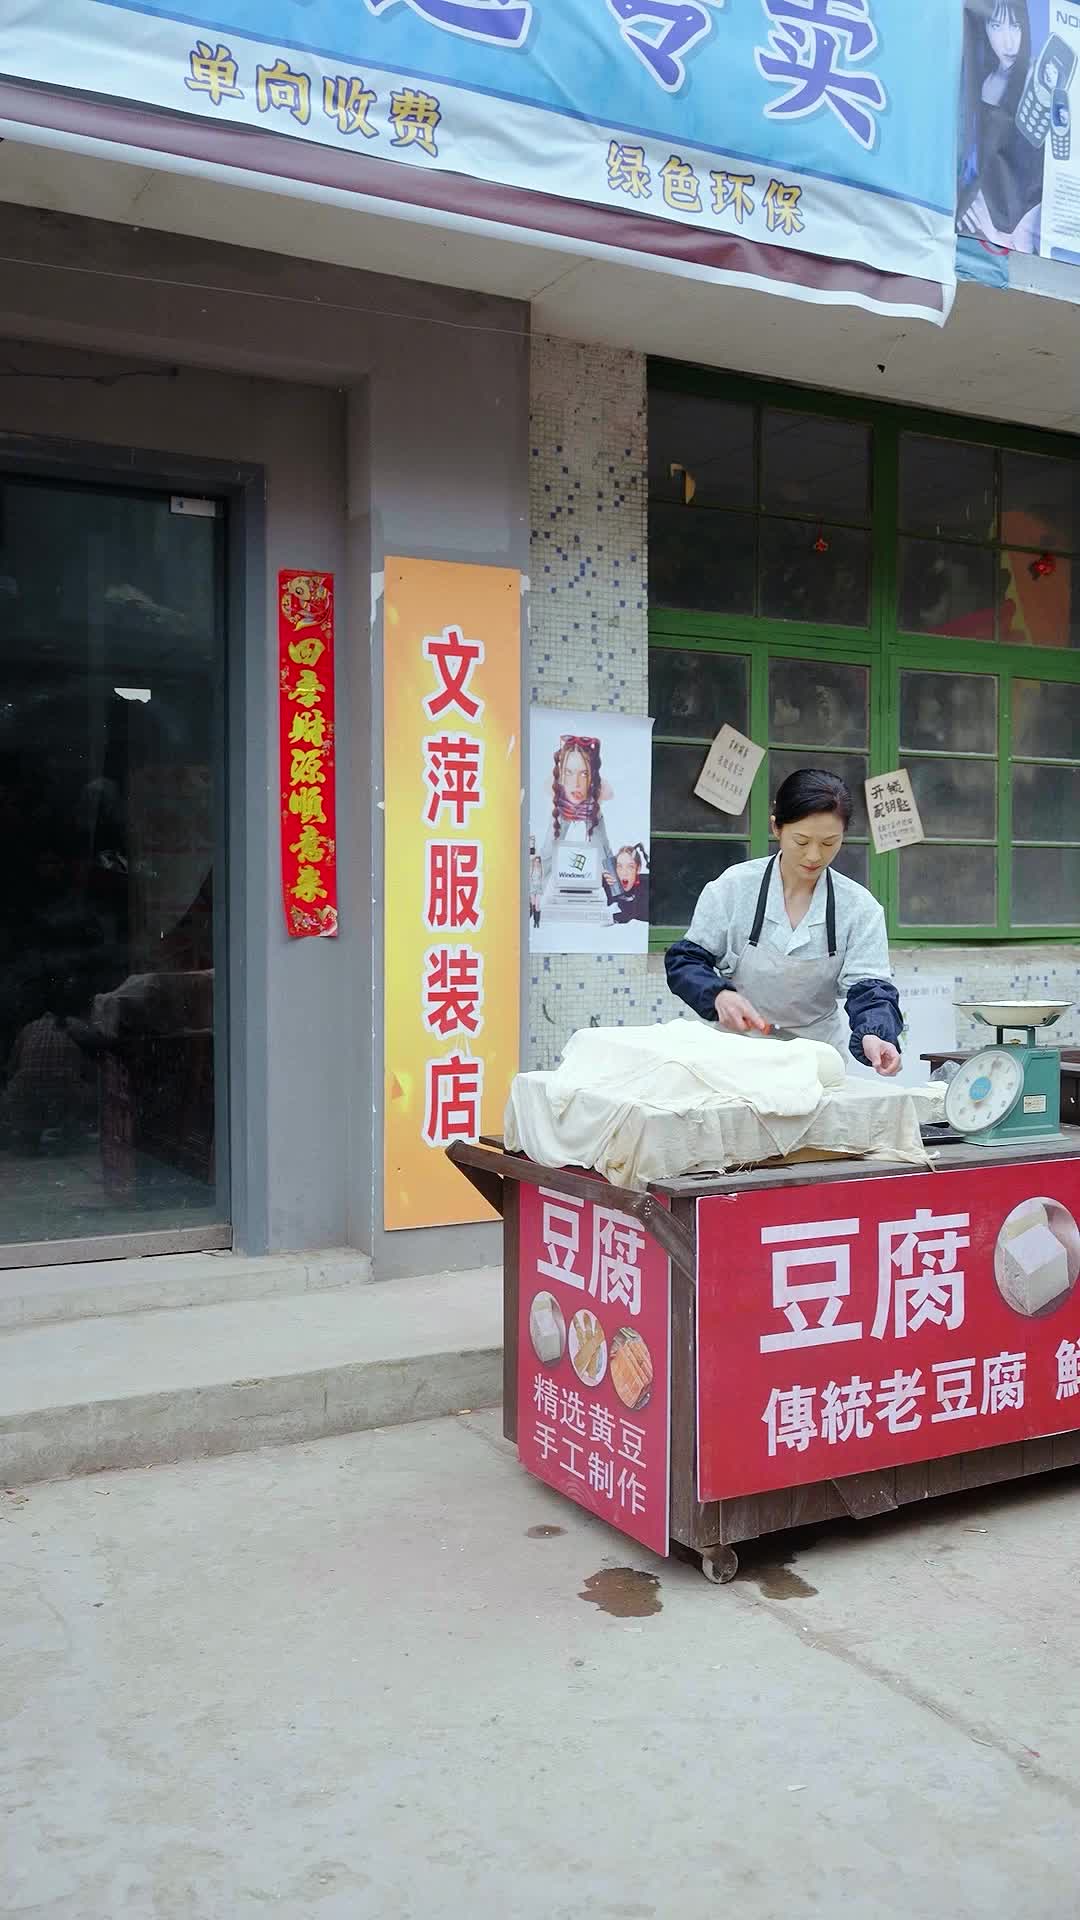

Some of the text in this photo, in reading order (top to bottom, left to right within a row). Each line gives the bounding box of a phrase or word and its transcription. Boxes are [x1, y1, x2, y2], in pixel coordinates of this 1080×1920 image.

[1056, 10, 1080, 28] NO
[184, 40, 443, 158] 单向收费
[606, 139, 806, 235] 绿色环保
[422, 627, 484, 1147] 文萍服装店
[537, 1186, 647, 1316] 豆腐
[759, 1208, 971, 1354] 豆腐
[533, 1372, 647, 1469] 精选黄豆
[761, 1351, 1028, 1457] 傳統老豆腐
[533, 1420, 647, 1516] 手工制作
